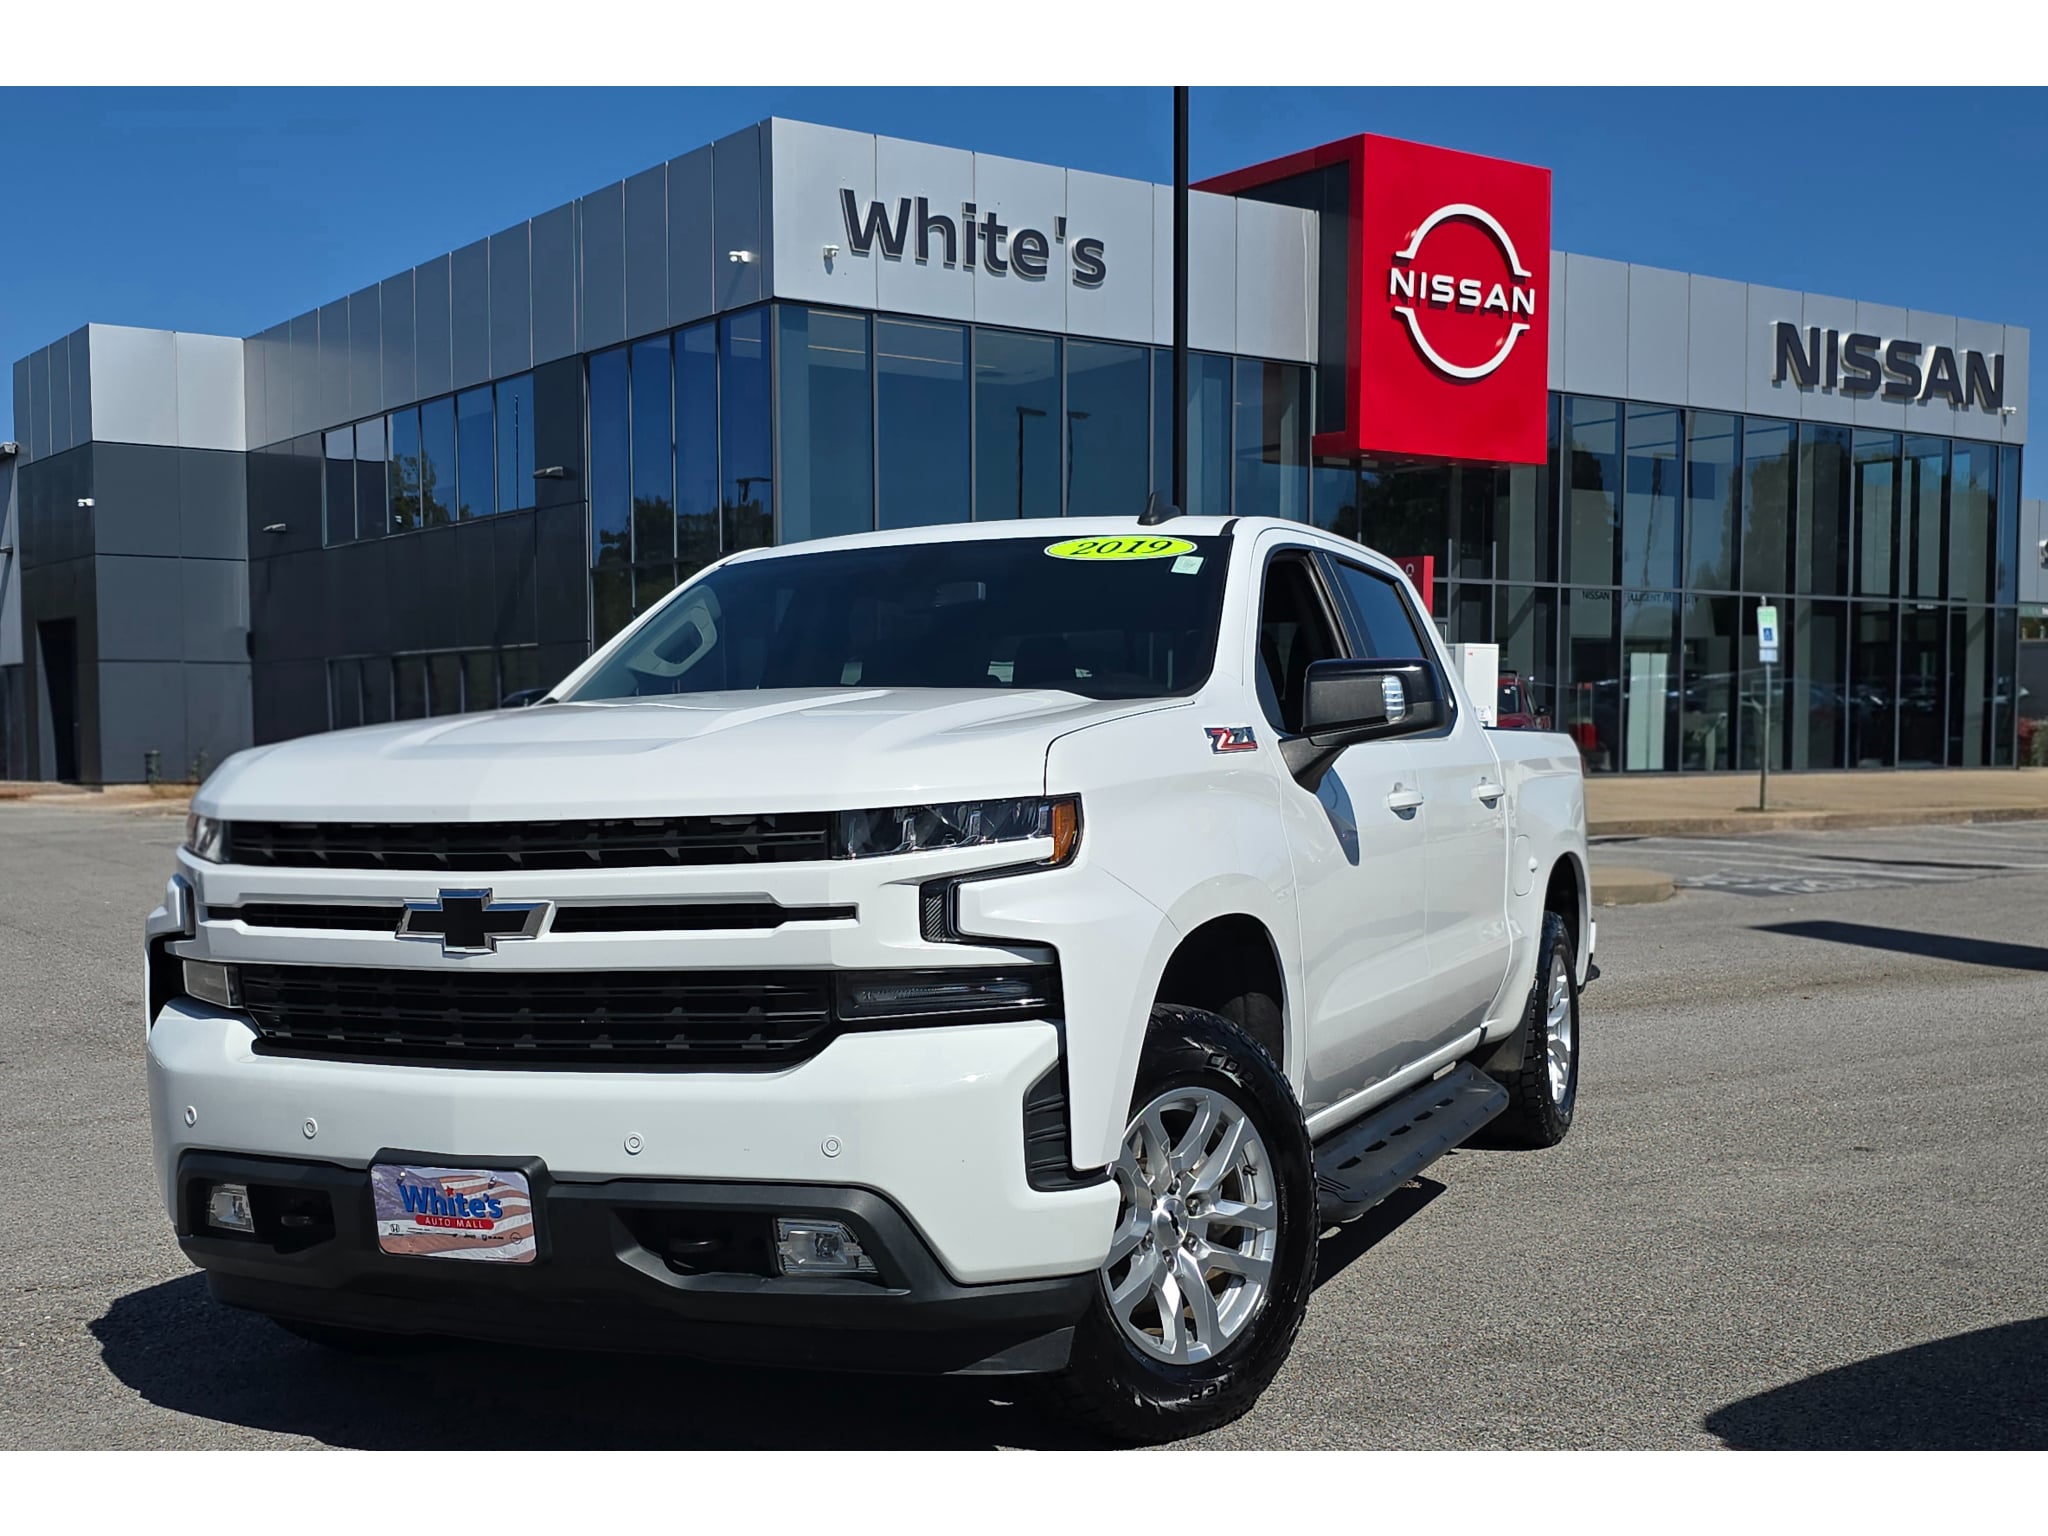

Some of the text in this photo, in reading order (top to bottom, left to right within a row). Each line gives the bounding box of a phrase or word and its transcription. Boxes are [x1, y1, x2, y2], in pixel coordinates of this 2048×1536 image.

[840, 188, 1107, 288] White's
[1390, 267, 1536, 315] NISSAN
[1771, 321, 2005, 411] NISSAN
[1070, 541, 1173, 555] 2019
[398, 1183, 503, 1219] White's
[425, 1217, 484, 1229] AUTO MALL
